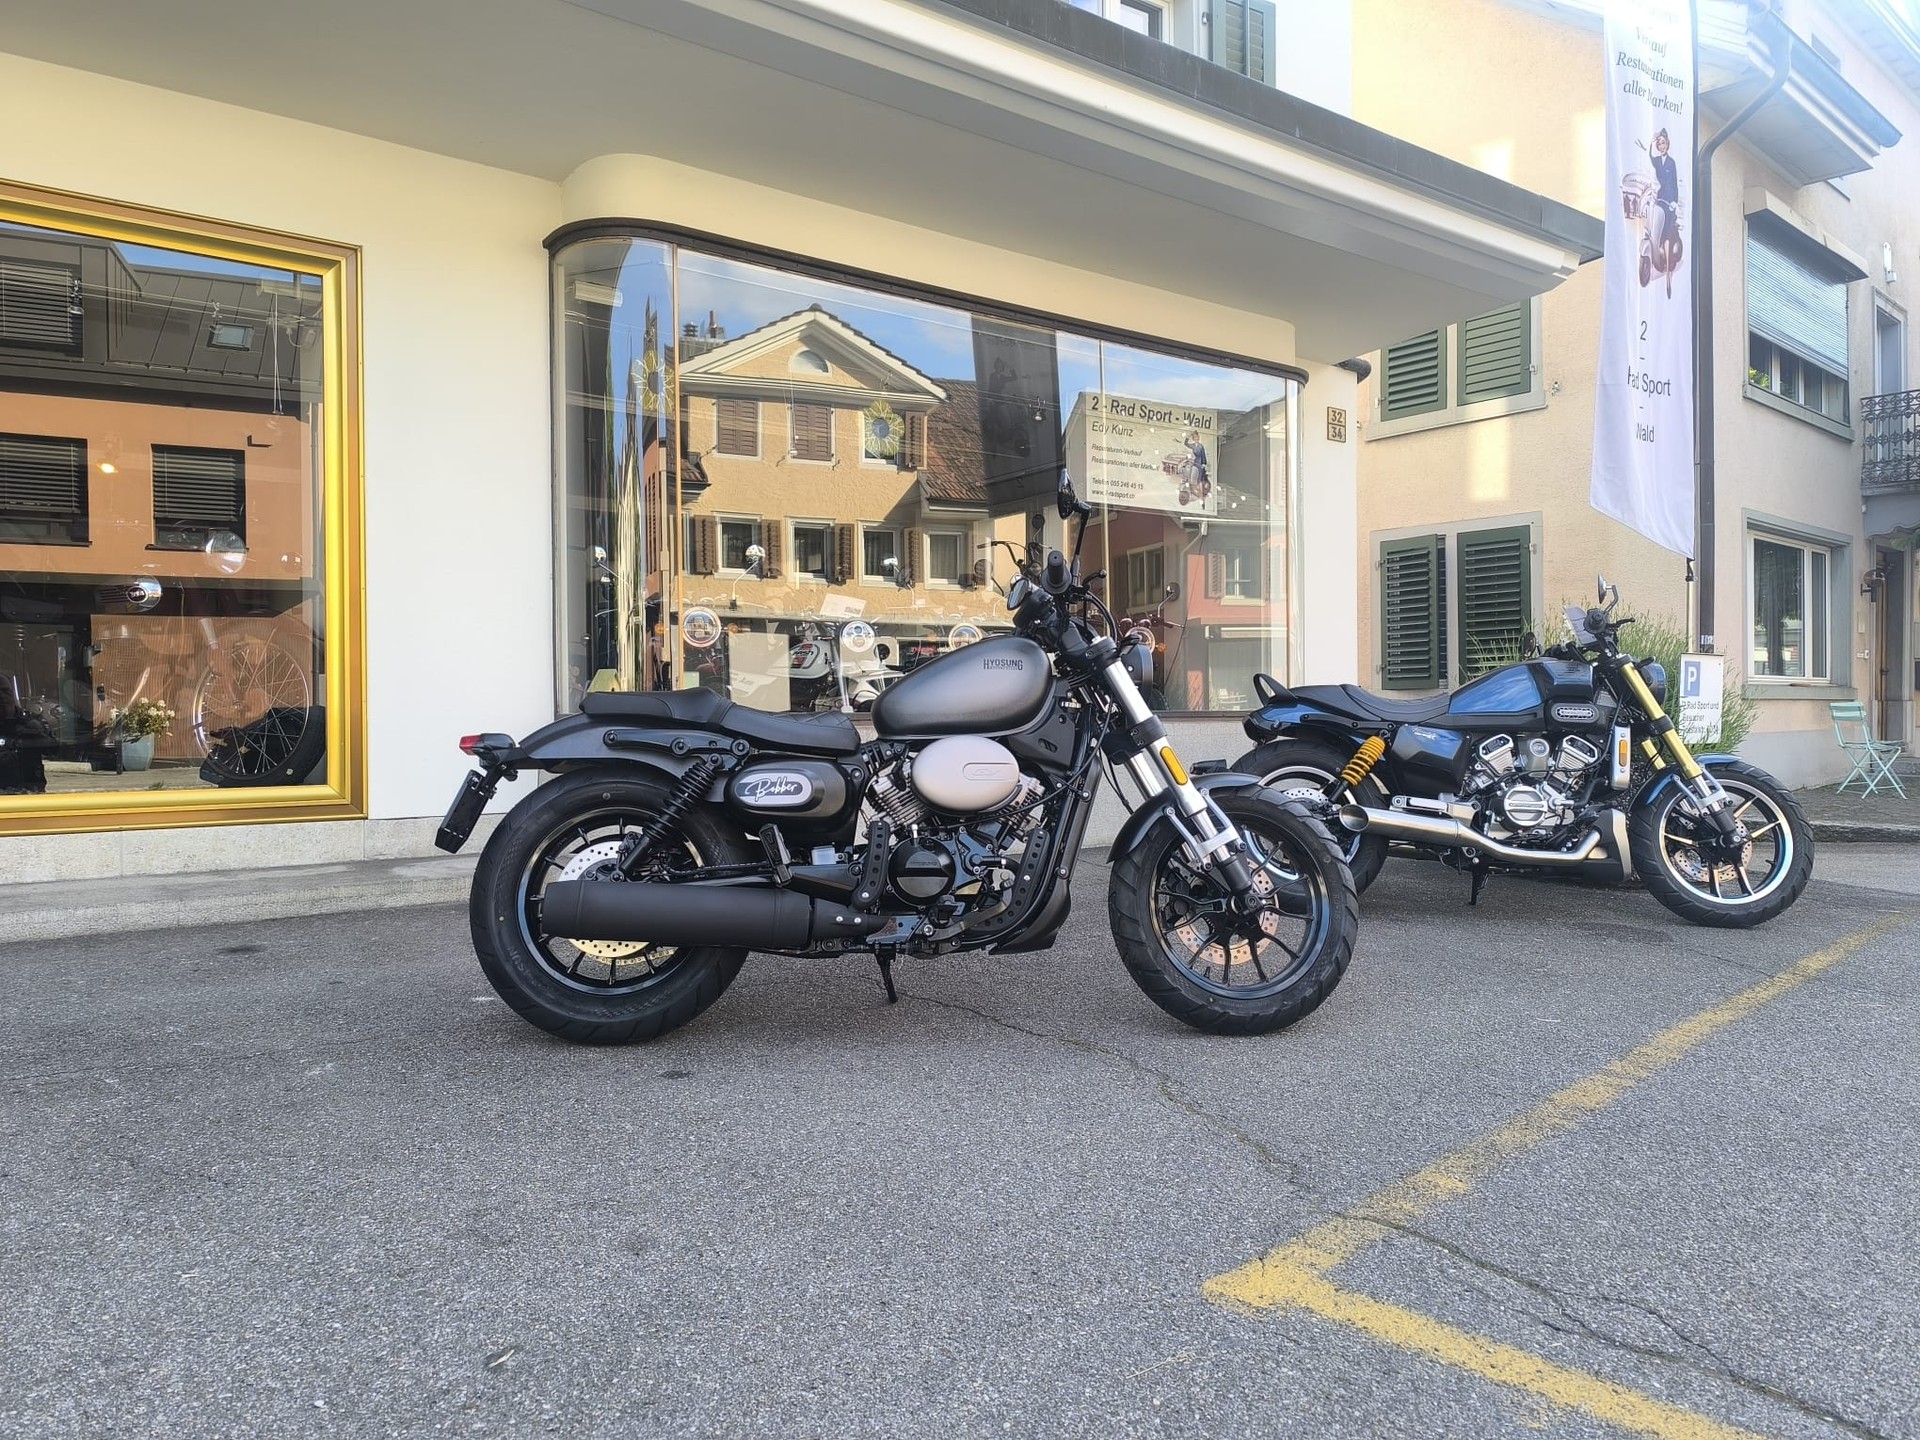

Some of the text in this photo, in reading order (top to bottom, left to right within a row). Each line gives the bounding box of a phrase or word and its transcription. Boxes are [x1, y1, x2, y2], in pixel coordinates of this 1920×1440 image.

[1636, 26, 1668, 58] Verauf
[1623, 79, 1647, 98] aller
[1640, 320, 1648, 341] 2
[1641, 373, 1671, 398] Sport
[1091, 395, 1099, 411] 2
[1110, 399, 1136, 417] Rad
[1138, 404, 1173, 423] Sport
[1183, 411, 1212, 430] Wald
[1331, 409, 1343, 424] 32
[1091, 420, 1110, 436] Edy
[1331, 426, 1343, 440] 34
[1091, 443, 1143, 457] Repaaturen-Verkauf
[1091, 455, 1129, 467] Resturationen
[1092, 477, 1109, 487] Telefn
[983, 658, 1023, 671] HYOSUNG
[1687, 666, 1697, 691] P
[744, 776, 798, 802] Bobber
